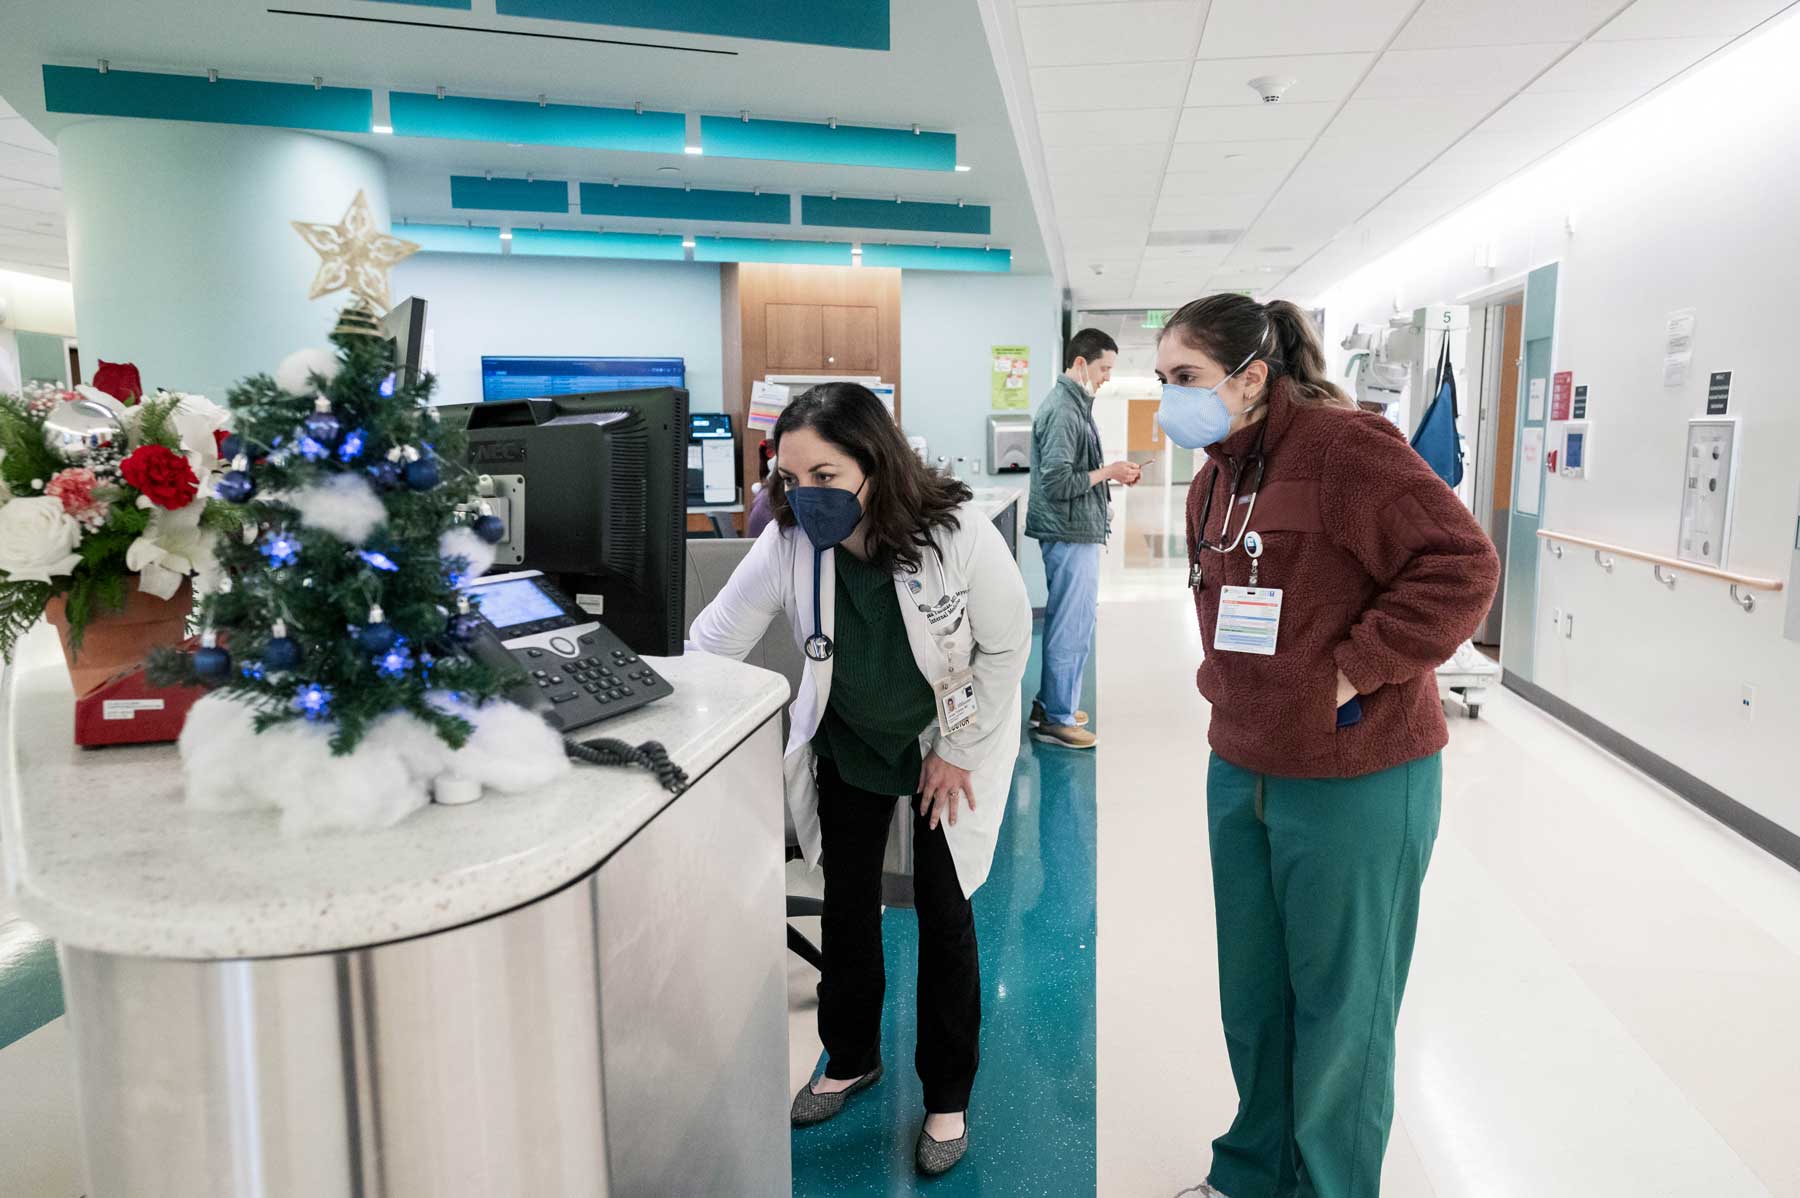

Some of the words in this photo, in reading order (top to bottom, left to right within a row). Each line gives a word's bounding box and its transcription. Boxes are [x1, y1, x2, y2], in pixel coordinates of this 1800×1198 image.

[1443, 311, 1452, 324] 5
[478, 443, 518, 460] NEC
[929, 611, 949, 625] Internal
